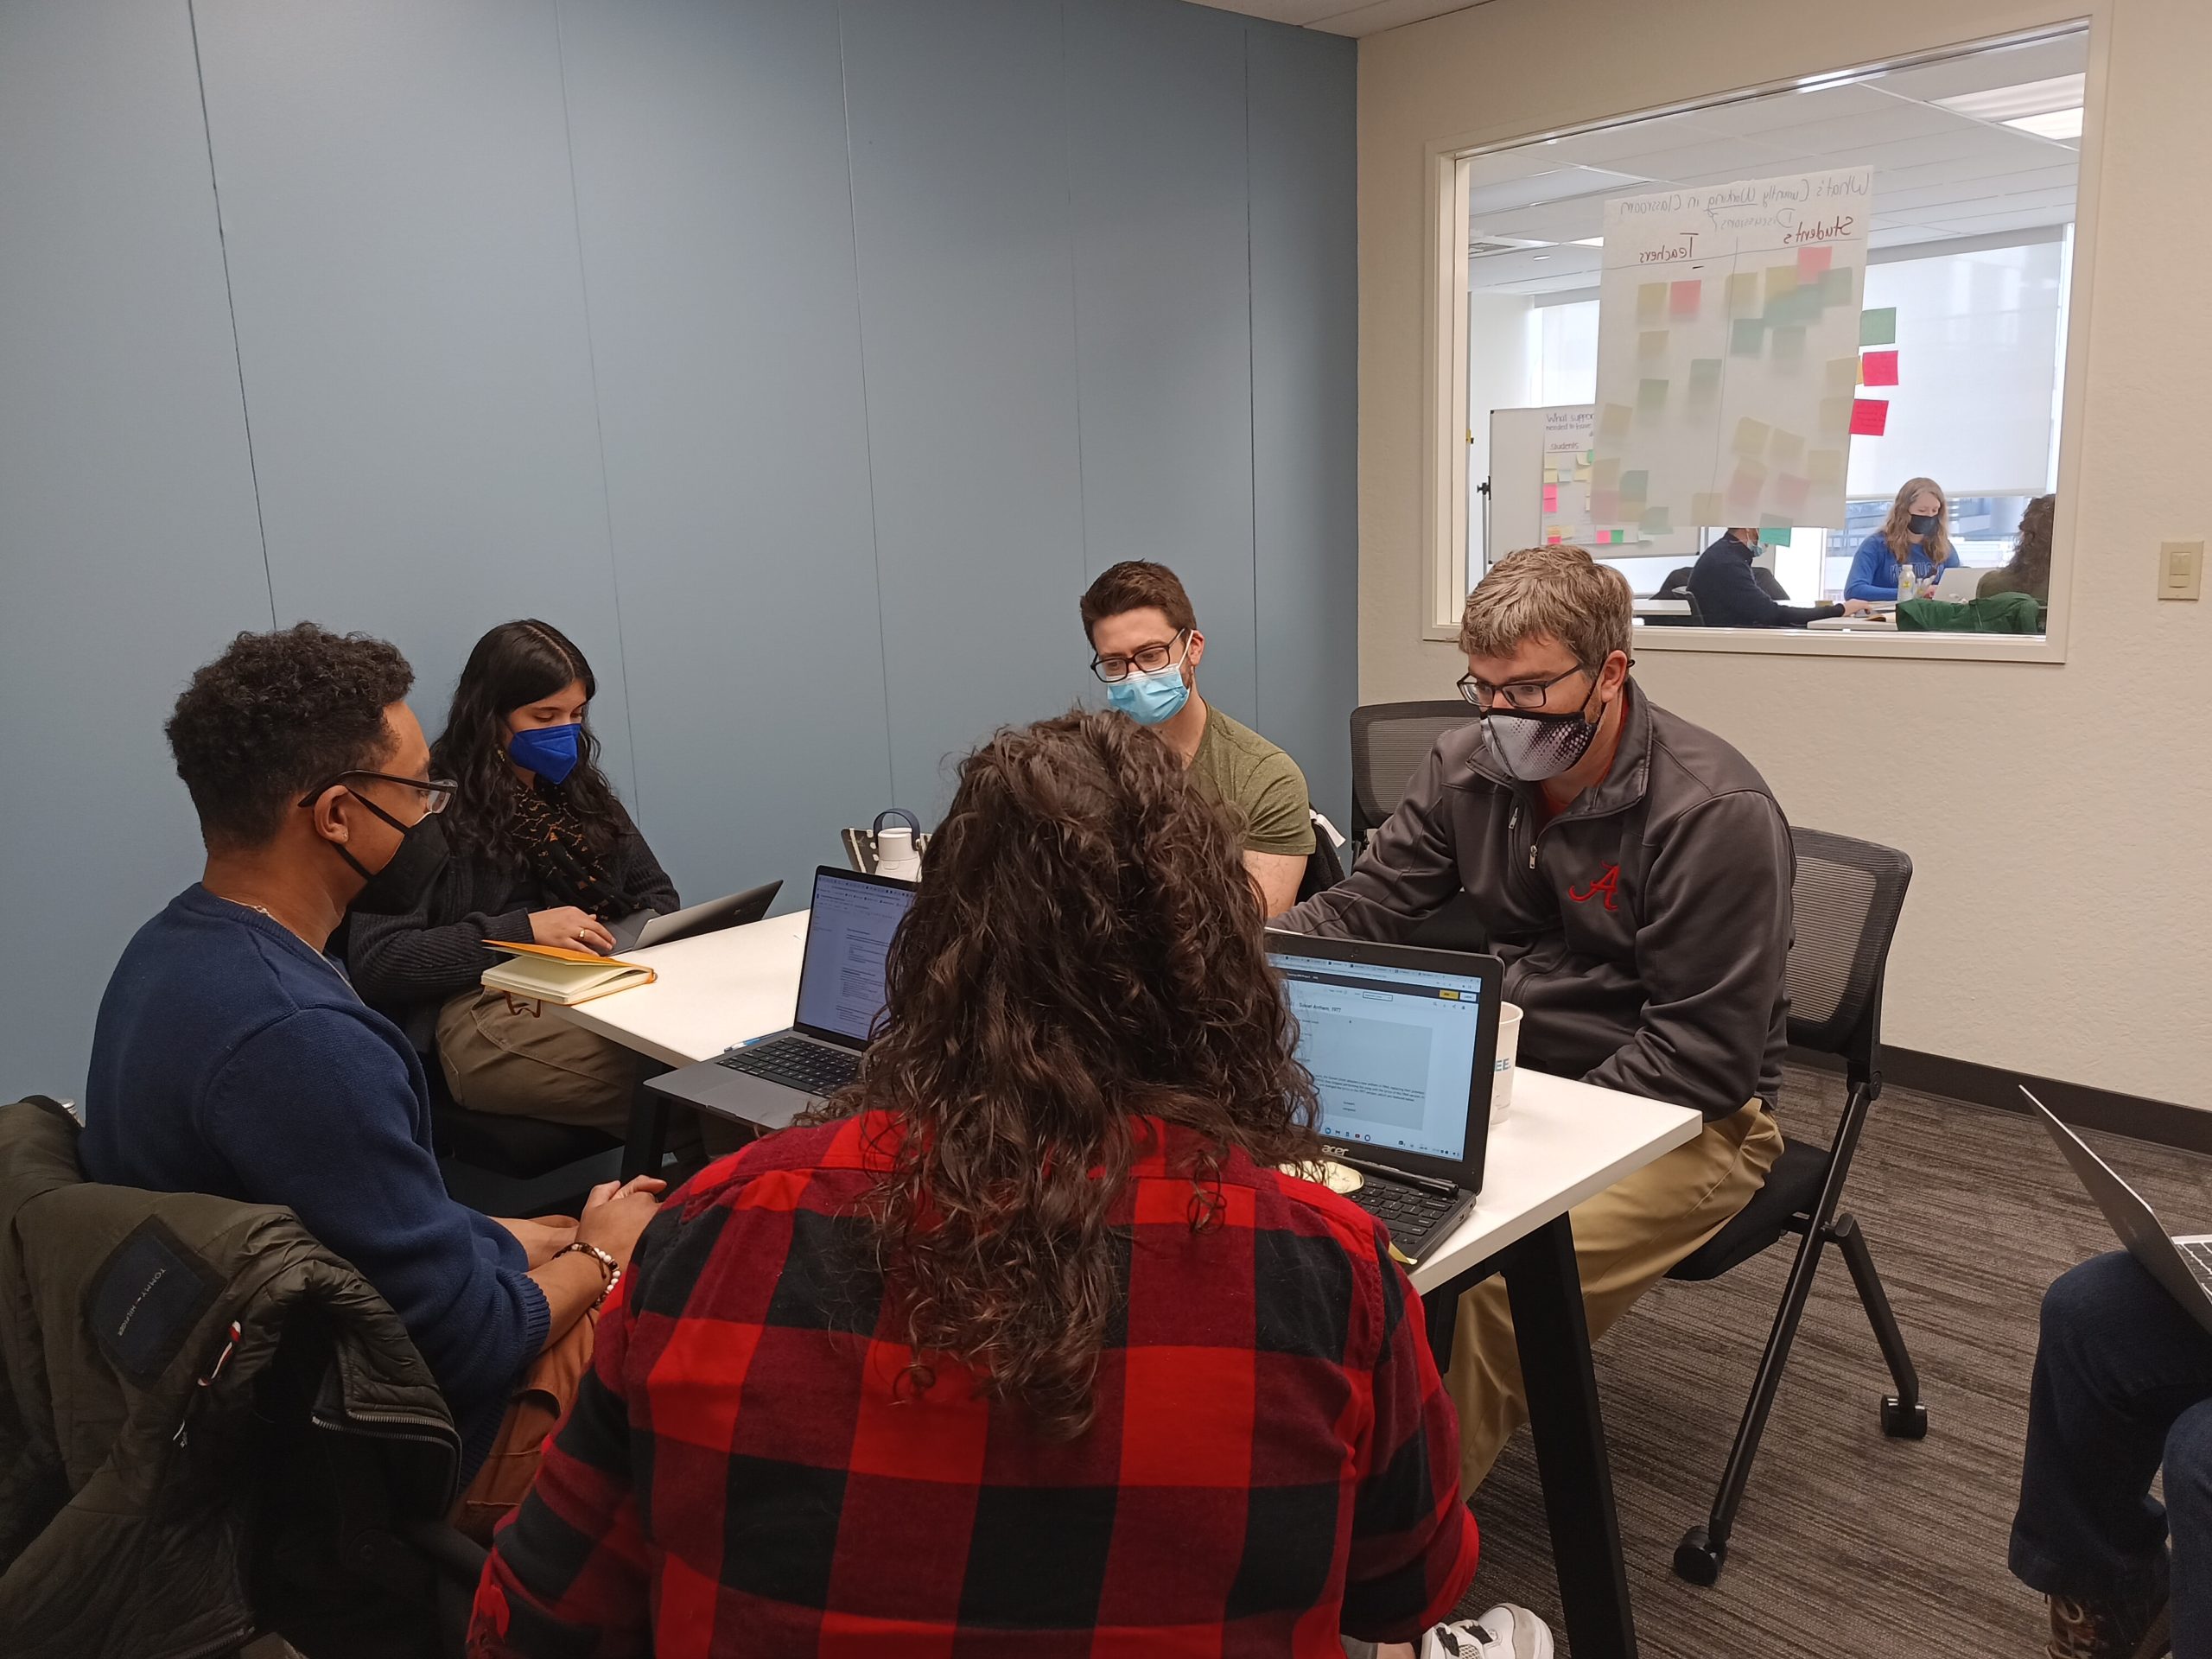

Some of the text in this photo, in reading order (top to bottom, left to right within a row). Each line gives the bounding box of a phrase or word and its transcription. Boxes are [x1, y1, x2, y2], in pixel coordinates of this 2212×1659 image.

[1546, 413, 1567, 423] What
[1568, 860, 1620, 912] A
[1321, 1143, 1350, 1157] acer
[142, 1268, 167, 1298] TOMMY
